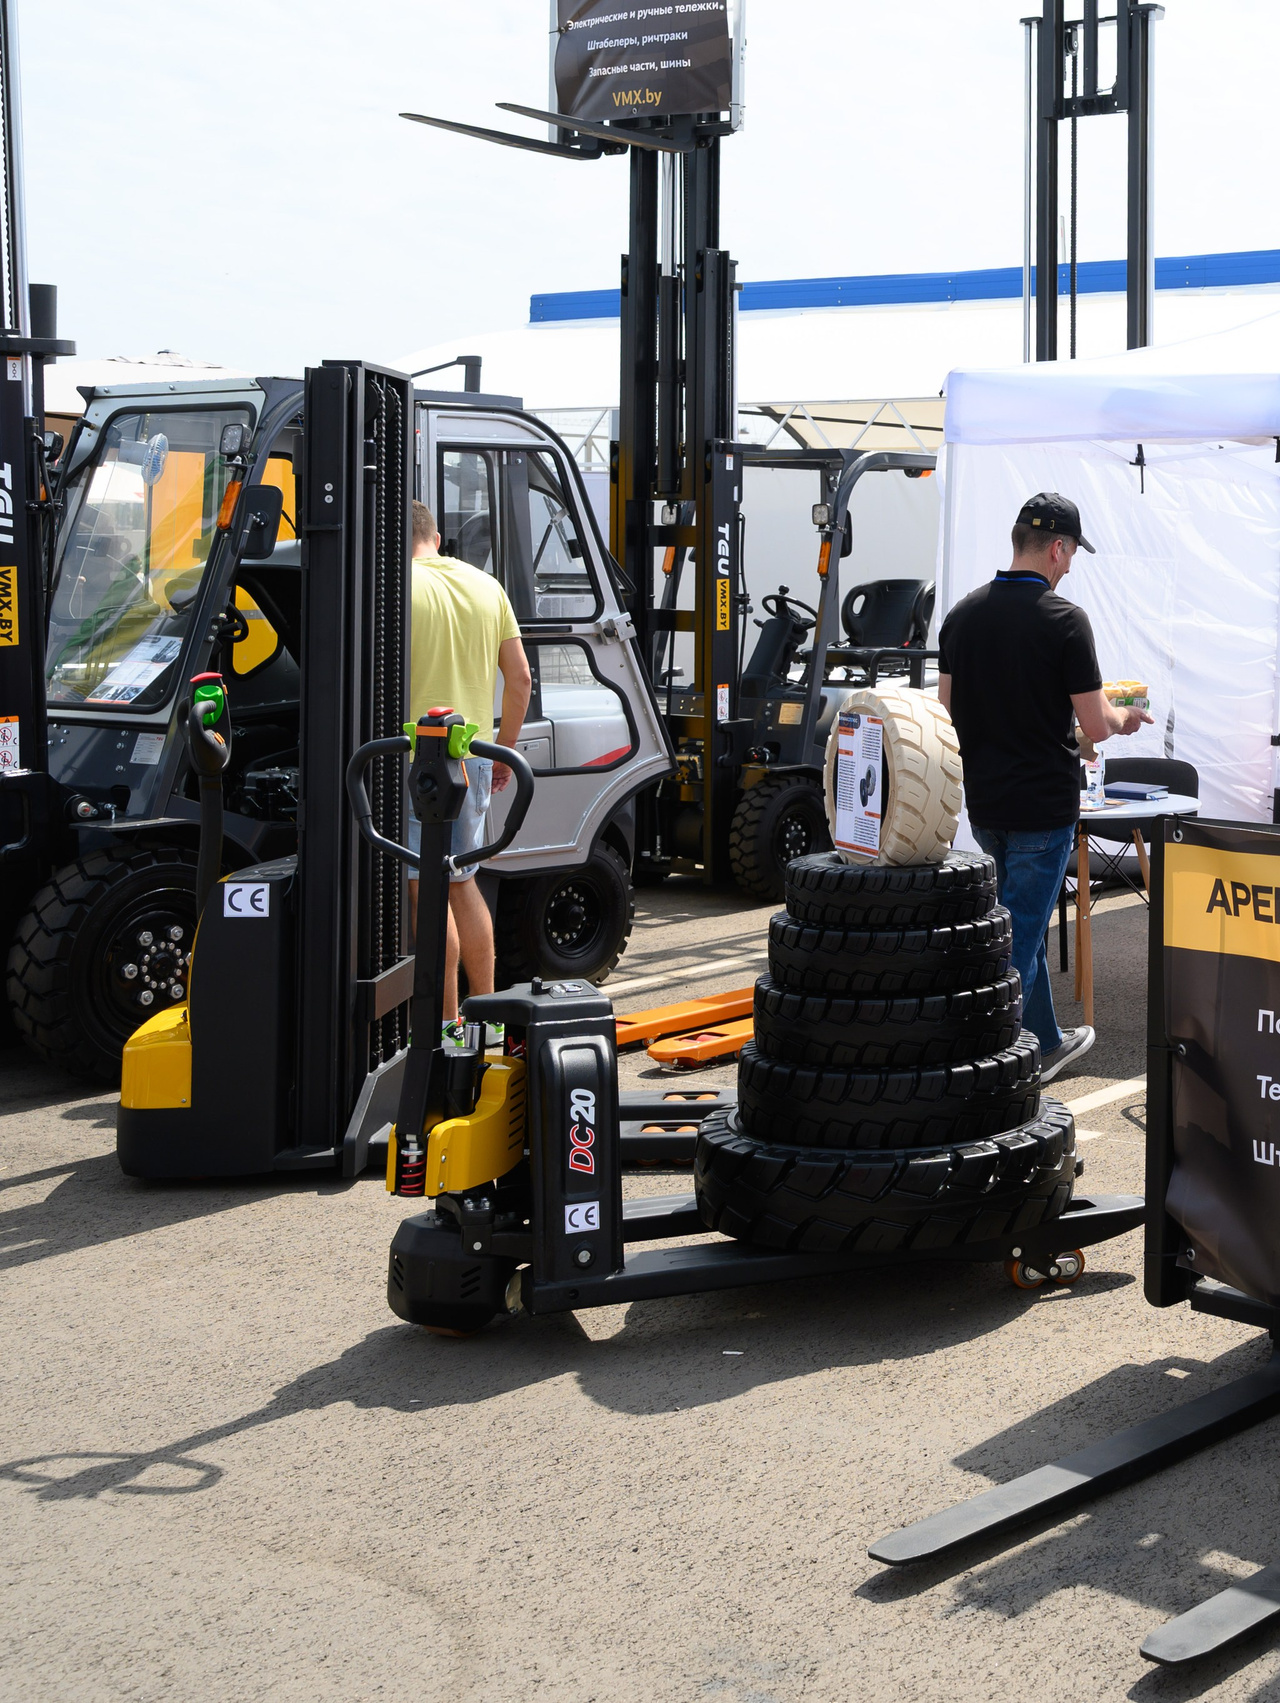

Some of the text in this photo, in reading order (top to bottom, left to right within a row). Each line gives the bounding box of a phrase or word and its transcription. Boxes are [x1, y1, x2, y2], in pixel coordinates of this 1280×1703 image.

[566, 1, 719, 31] Электрические и ручные тележки
[587, 30, 688, 51] Штабелеры, ричтраки
[589, 58, 691, 78] Запасные части, шины
[612, 88, 662, 107] VMX.by
[718, 580, 728, 628] VMX.BY
[568, 1088, 596, 1175] DC20
